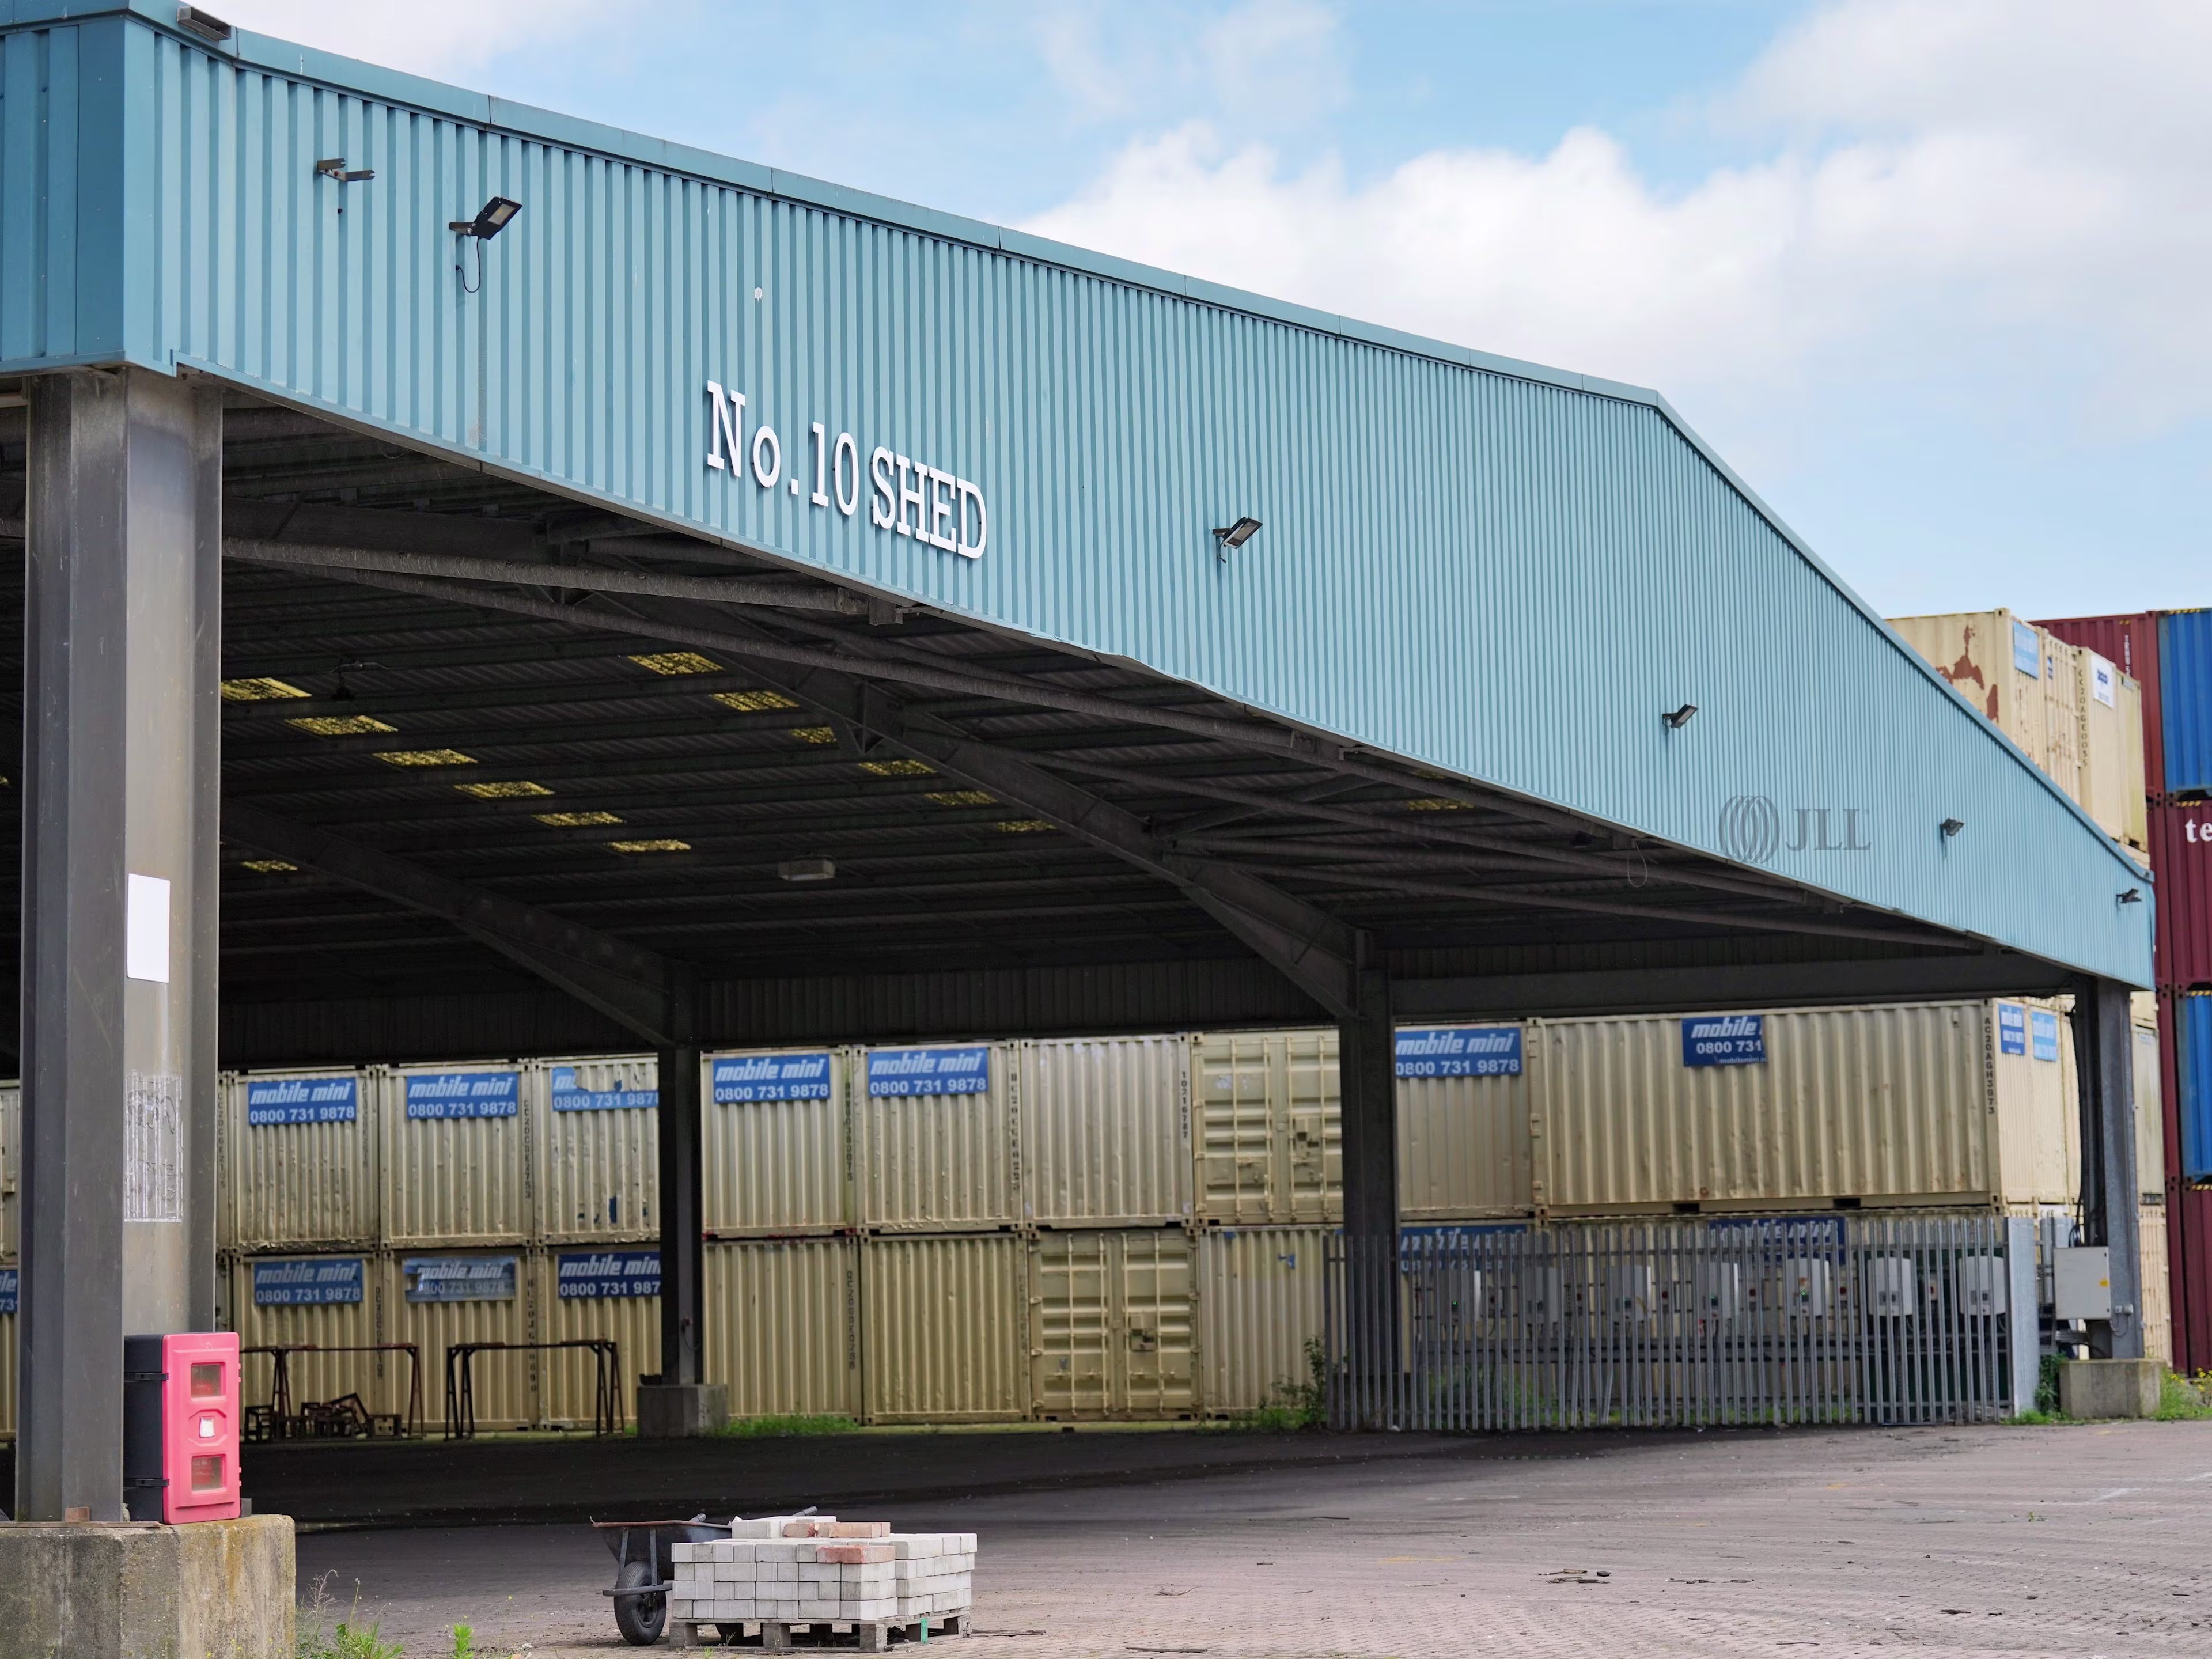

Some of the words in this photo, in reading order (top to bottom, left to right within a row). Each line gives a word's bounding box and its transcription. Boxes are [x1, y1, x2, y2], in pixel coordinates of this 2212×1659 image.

[872, 446, 987, 559] SHED
[1691, 1016, 1757, 1038] mobile
[1395, 1032, 1465, 1055] mobile
[1467, 1033, 1515, 1053] mini
[1696, 1041, 1732, 1054] 0800
[1736, 1040, 1762, 1052] 731
[715, 1058, 779, 1081] mobile
[781, 1059, 825, 1078] mini
[870, 1052, 936, 1075] mobile
[938, 1052, 983, 1073] mini
[1395, 1062, 1435, 1075] 0800
[1441, 1060, 1470, 1074] 731
[1477, 1059, 1519, 1073] 9878
[250, 1081, 309, 1105] mobile
[311, 1081, 351, 1101] mini
[409, 1076, 469, 1097] mobile
[471, 1077, 513, 1096] mini
[715, 1087, 753, 1100] 0800
[757, 1086, 784, 1099] 731
[790, 1084, 829, 1097] 9878
[870, 1081, 908, 1094] 0800
[914, 1080, 941, 1092] 731
[948, 1078, 986, 1092] 9878
[408, 1103, 444, 1116] 0800
[449, 1103, 474, 1115] 731
[480, 1101, 516, 1115] 9878
[554, 1096, 590, 1108] 0800
[595, 1094, 622, 1107] 731
[250, 1109, 285, 1123] 0800
[290, 1108, 315, 1121] 731
[320, 1106, 354, 1119] 9878
[256, 1262, 315, 1284] mobile
[317, 1263, 358, 1282] mini
[468, 1262, 505, 1278] mini
[559, 1255, 622, 1277] mobile
[624, 1256, 661, 1275] min
[256, 1290, 290, 1303] 0800
[296, 1289, 319, 1301] 731
[325, 1287, 361, 1300] 9878
[450, 1281, 471, 1294] 731
[476, 1280, 505, 1293] 9878
[559, 1283, 596, 1296] 0800
[601, 1282, 627, 1294] 731
